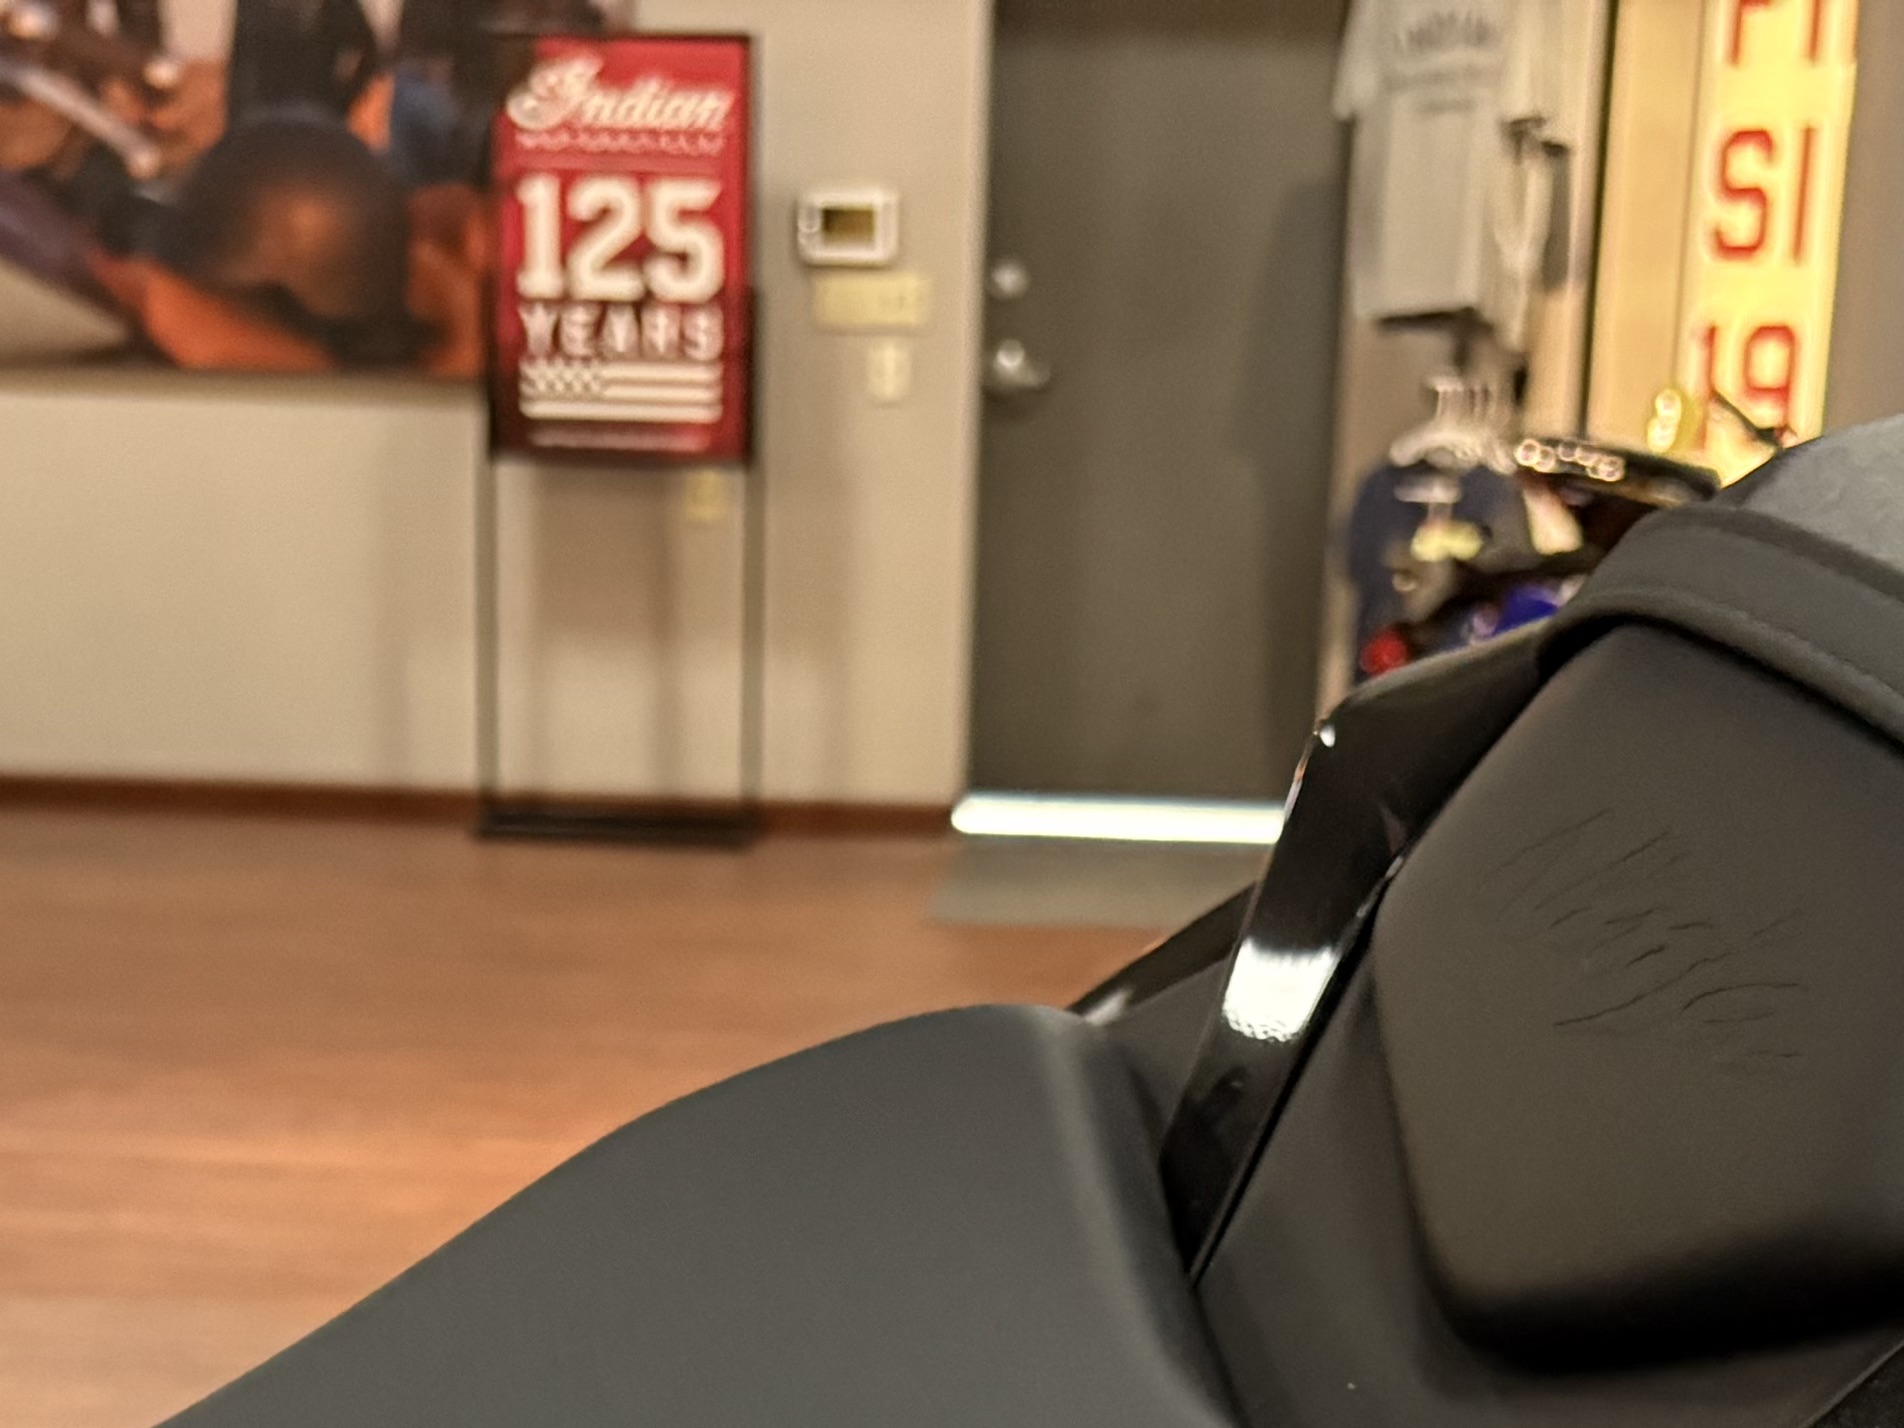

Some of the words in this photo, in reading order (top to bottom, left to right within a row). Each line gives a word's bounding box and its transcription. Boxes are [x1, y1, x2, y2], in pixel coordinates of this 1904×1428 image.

[507, 58, 736, 131] Indian
[515, 174, 725, 301] 125
[517, 302, 725, 361] YEARS
